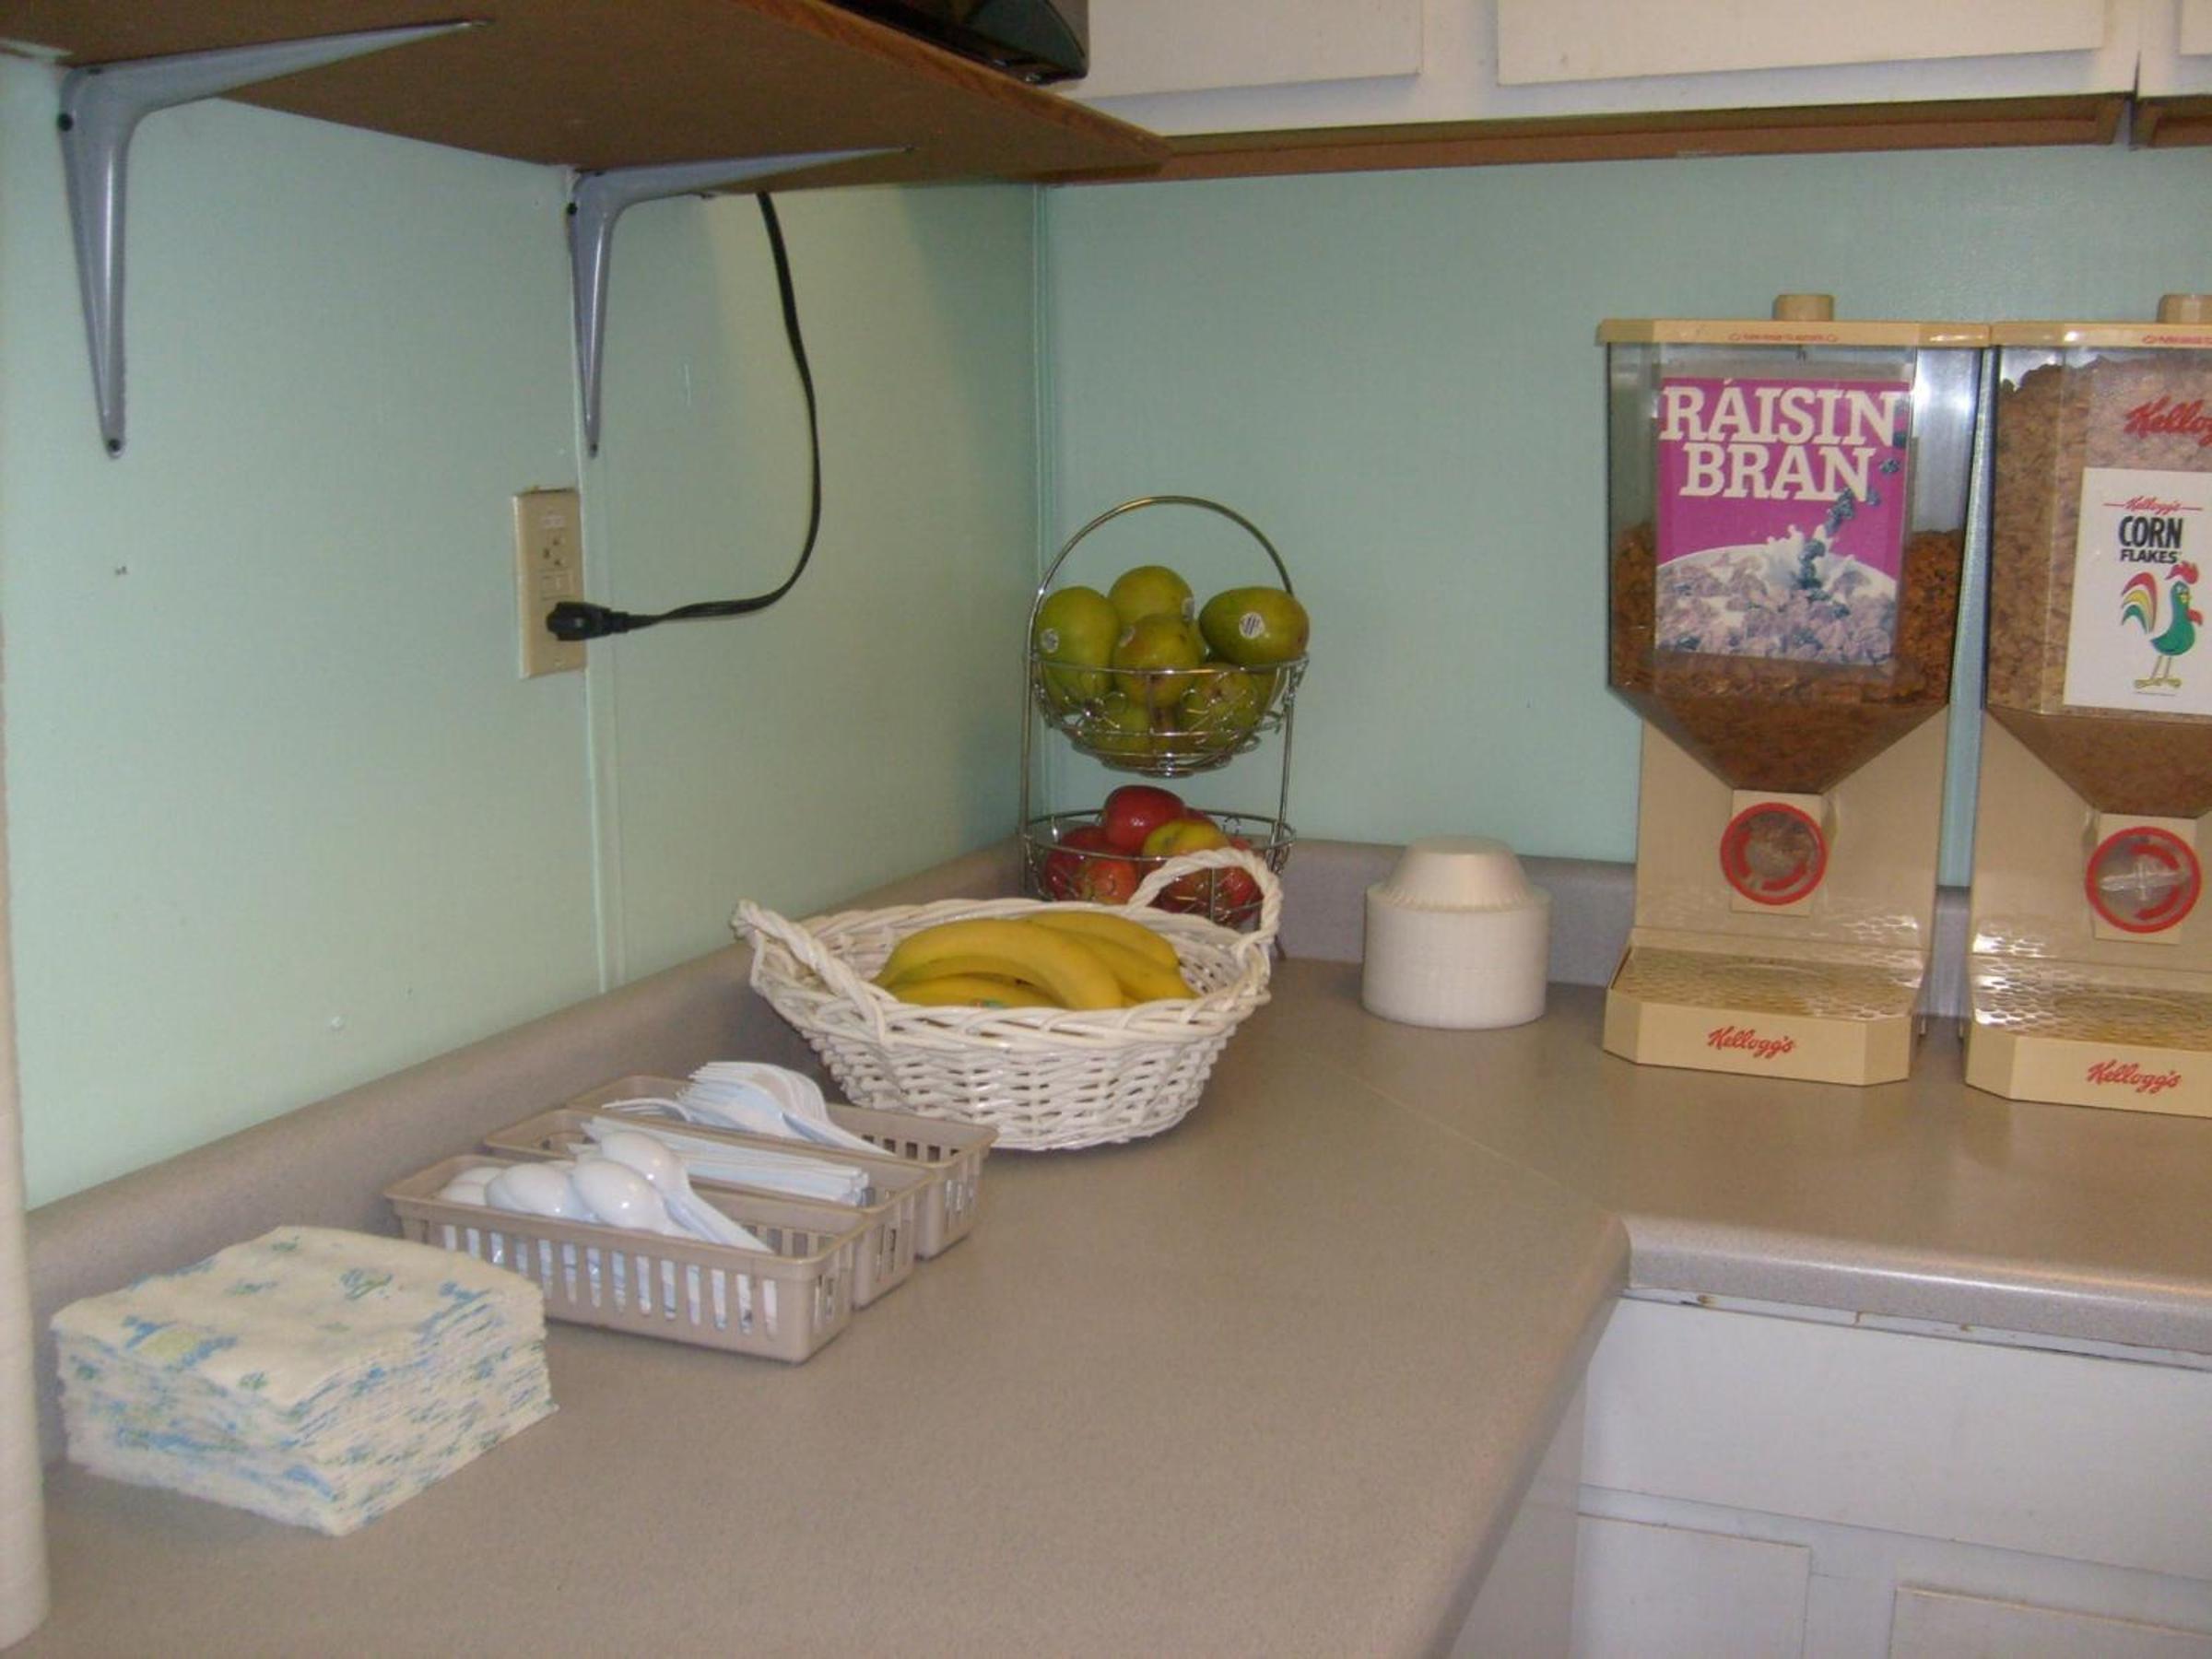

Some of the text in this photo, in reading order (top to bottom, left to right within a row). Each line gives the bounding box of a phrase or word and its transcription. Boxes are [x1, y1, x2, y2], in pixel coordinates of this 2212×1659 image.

[1659, 386, 1900, 446] RAISIN
[1678, 442, 1876, 501] BRAN
[2119, 516, 2183, 548] CORN
[2121, 548, 2178, 563] FLAKES
[1707, 1026, 1794, 1059] Kellogg's
[2087, 1059, 2182, 1094] Kellogg's
